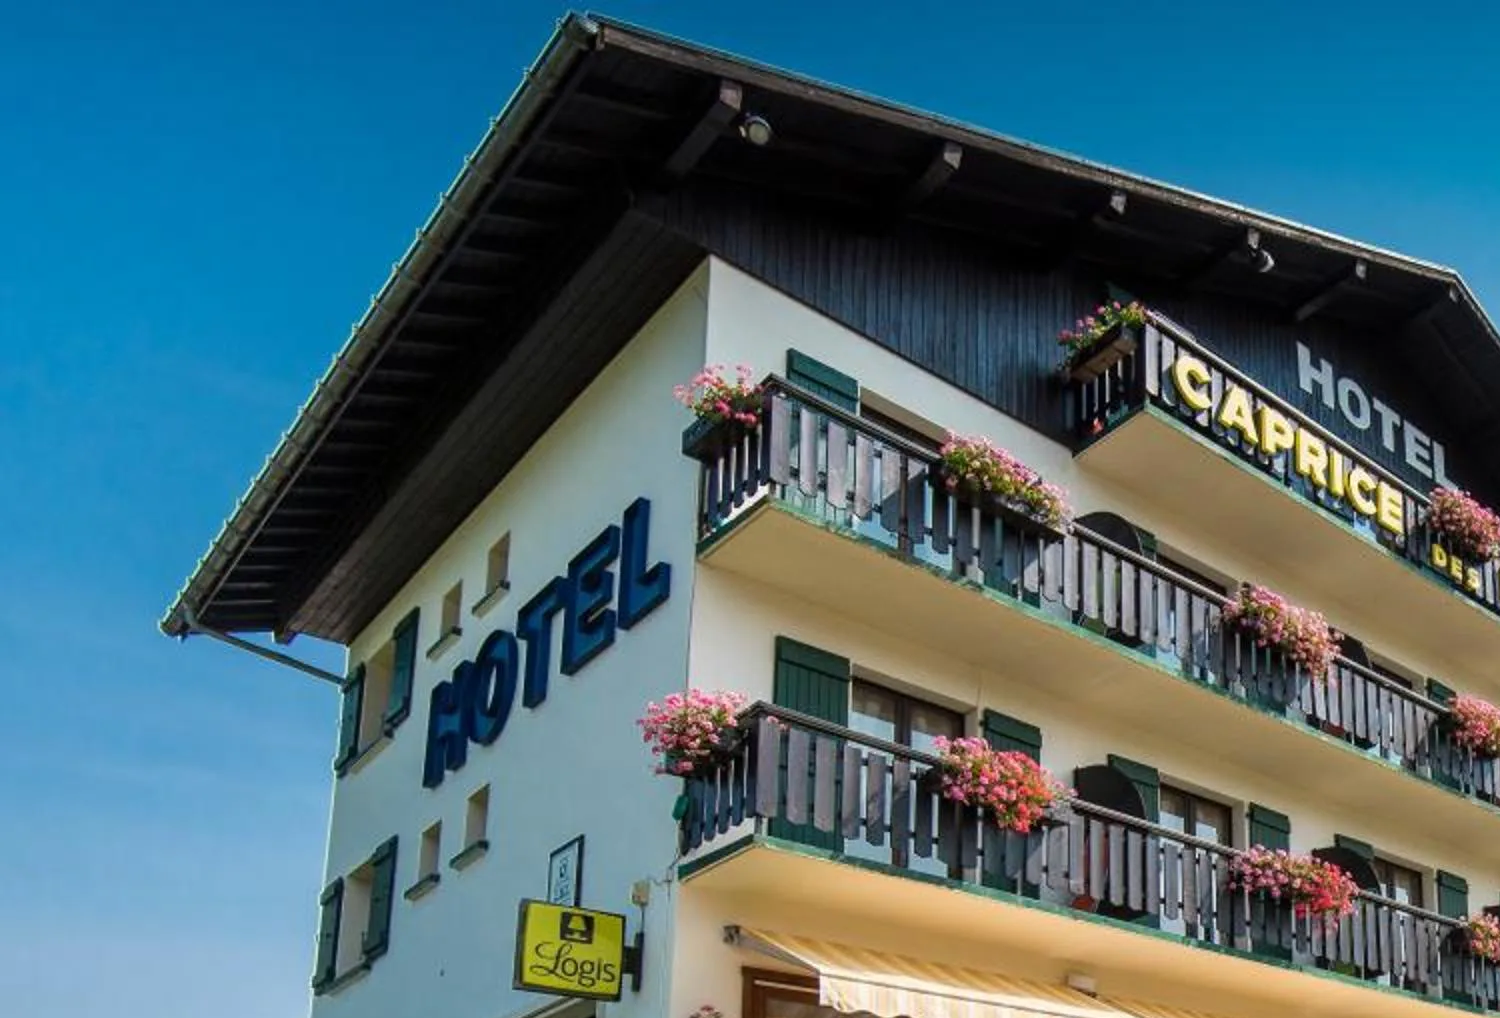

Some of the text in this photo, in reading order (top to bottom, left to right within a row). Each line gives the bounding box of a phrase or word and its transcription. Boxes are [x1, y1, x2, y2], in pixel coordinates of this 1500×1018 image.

[1173, 354, 1404, 535] CAPRICE
[1431, 543, 1481, 593] DES
[1296, 341, 1459, 492] HOTEL
[423, 496, 671, 788] HOTEL
[529, 941, 616, 988] Logis
